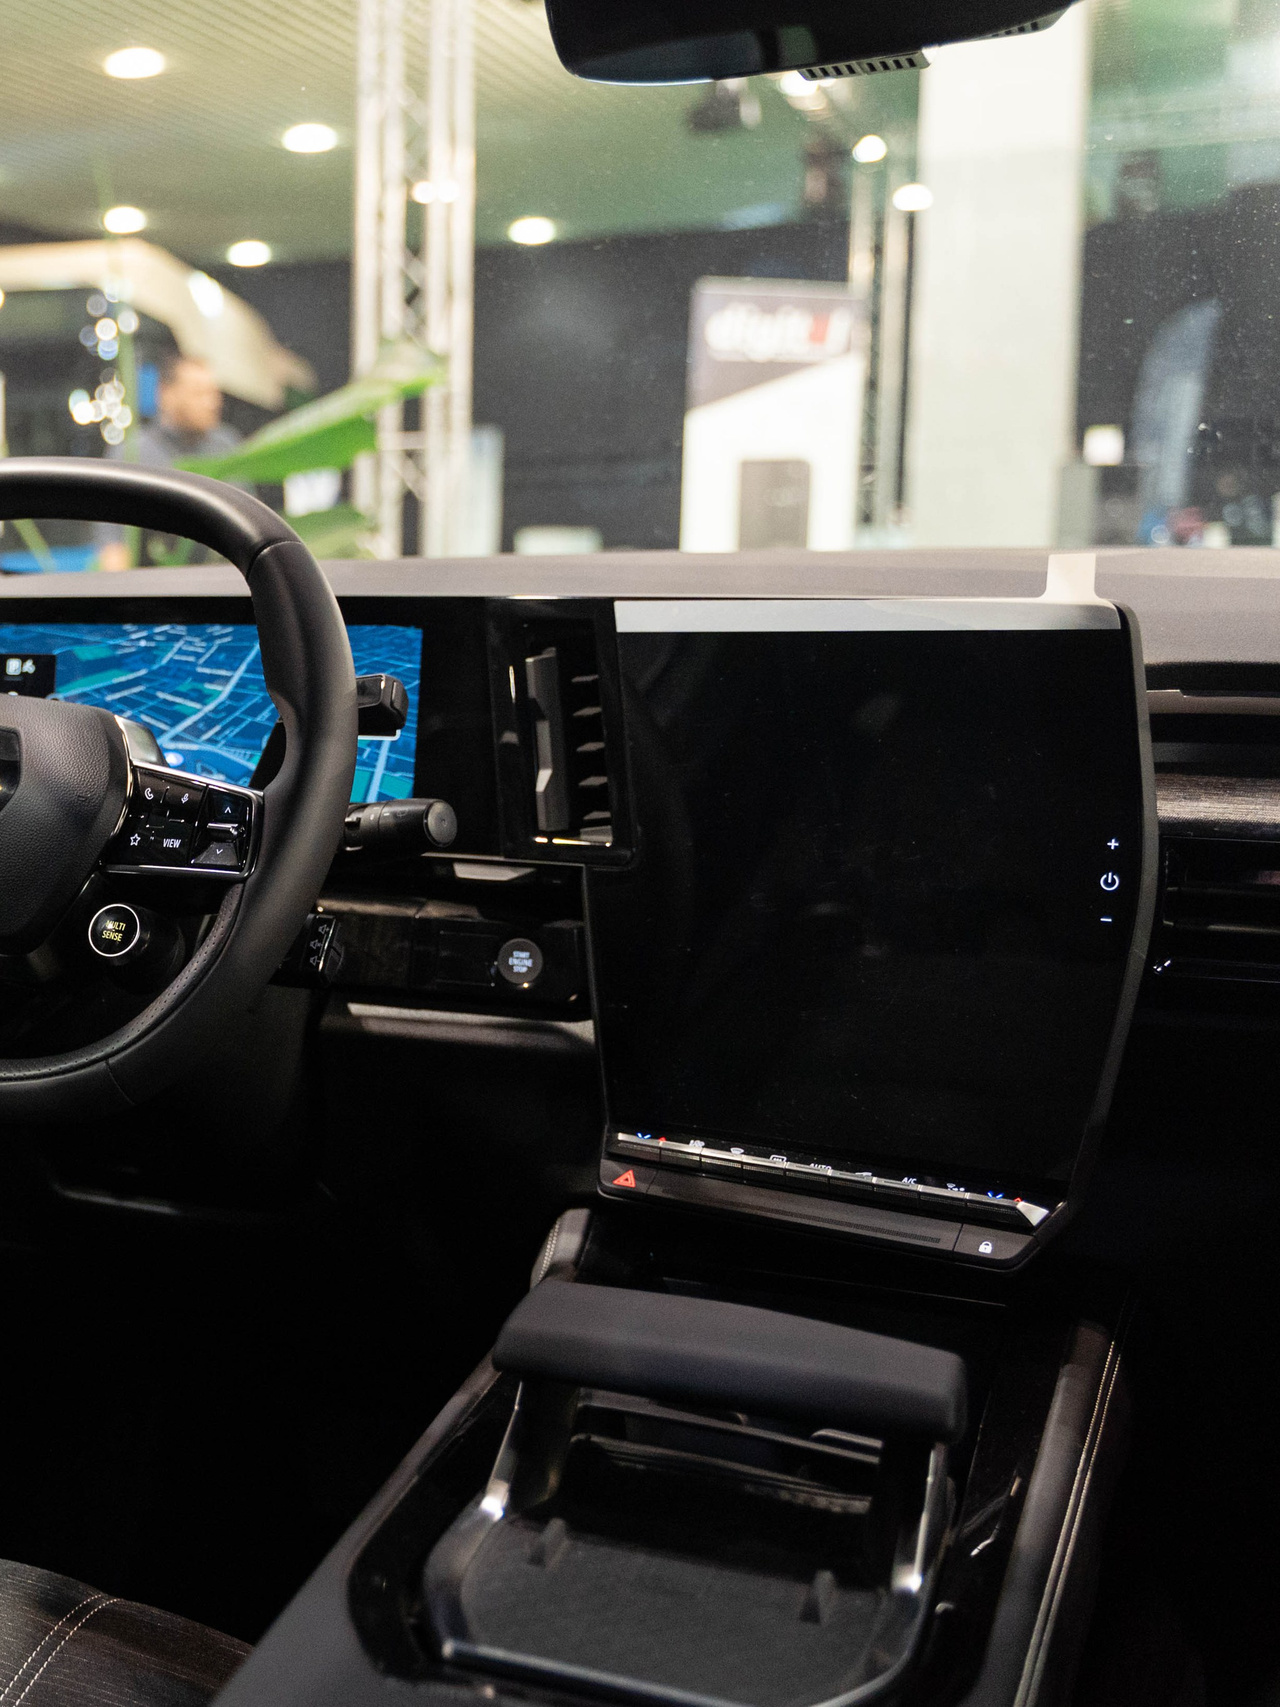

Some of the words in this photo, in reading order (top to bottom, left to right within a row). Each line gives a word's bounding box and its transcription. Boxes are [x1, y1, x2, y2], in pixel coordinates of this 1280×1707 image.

[163, 838, 181, 848] VIEW
[105, 920, 126, 931] MULTI
[102, 930, 123, 942] SENSE
[901, 1176, 918, 1185] A/C
